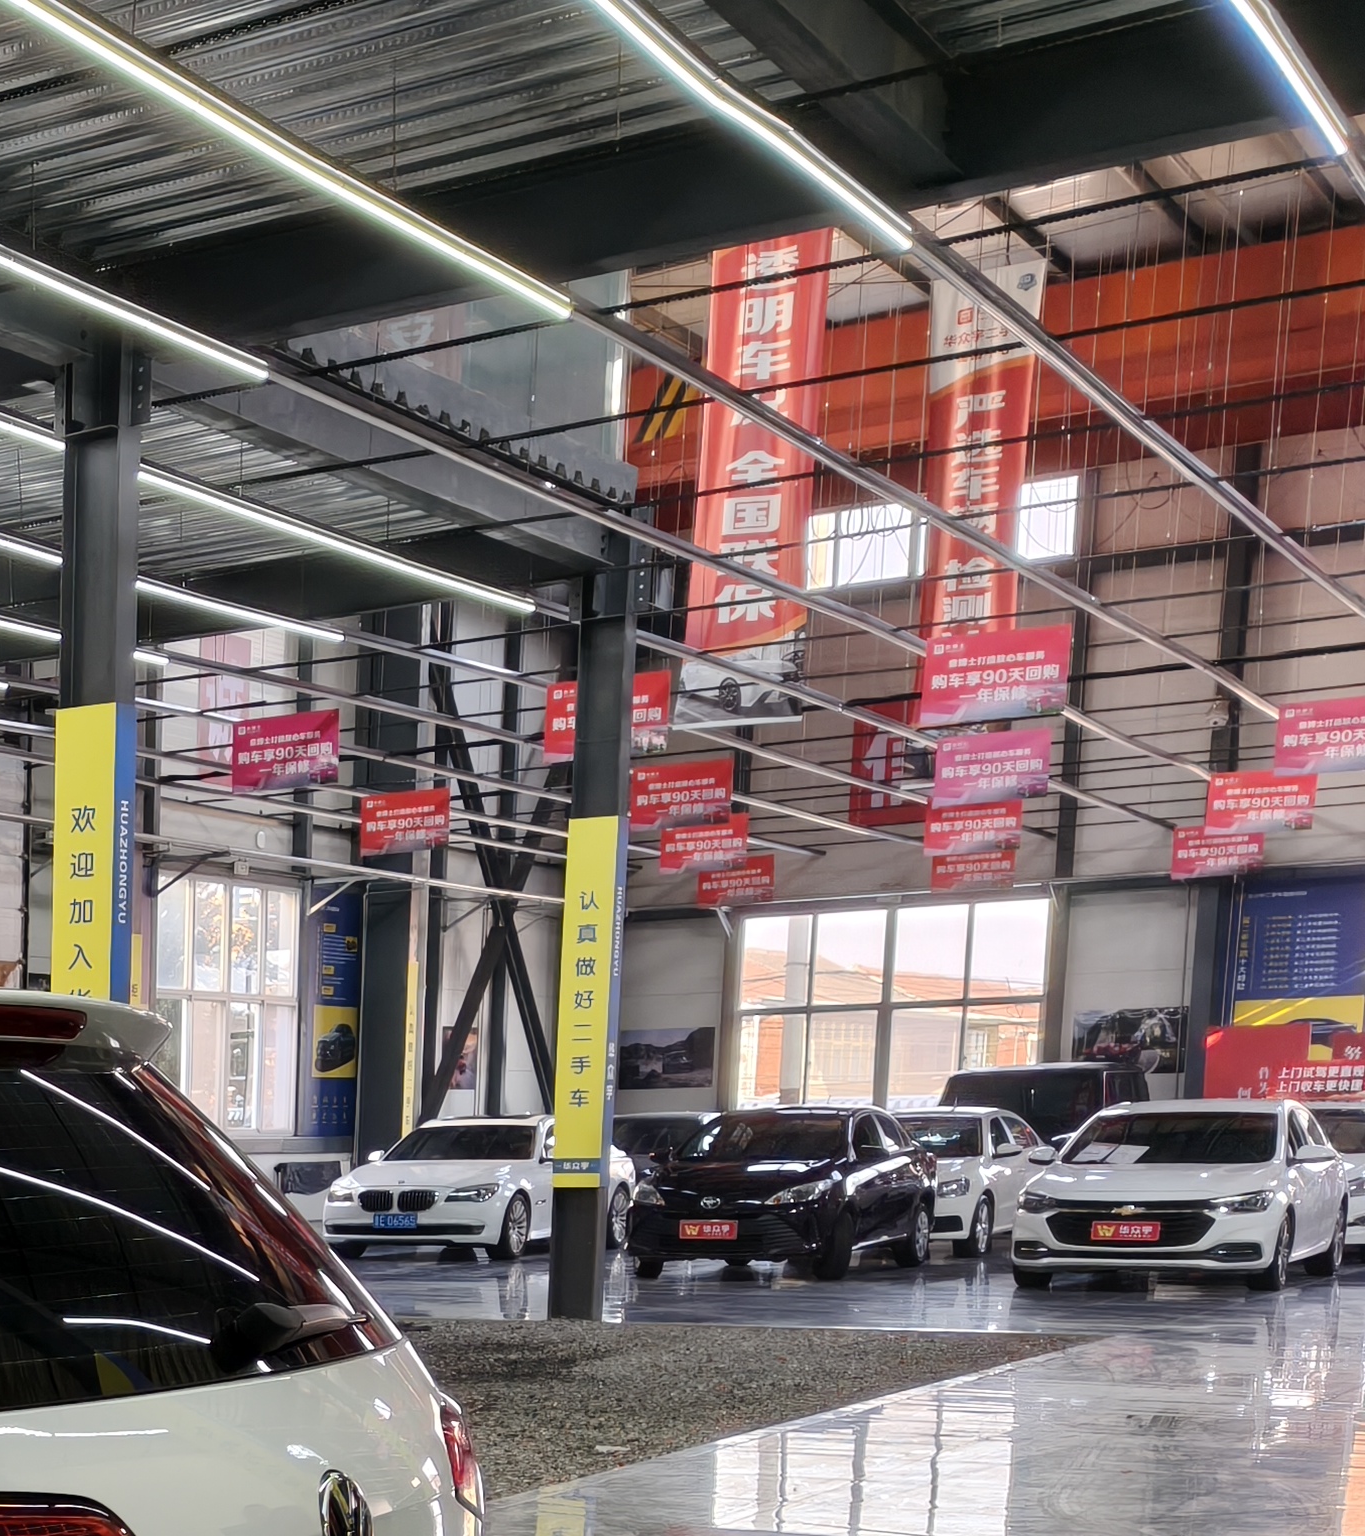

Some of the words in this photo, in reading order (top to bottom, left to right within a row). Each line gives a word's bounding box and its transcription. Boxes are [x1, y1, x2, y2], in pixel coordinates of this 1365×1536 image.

[943, 327, 1009, 348] 华众宇二手
[931, 664, 1060, 690] 购车享90天回购
[959, 685, 1028, 702] 一年保修
[237, 742, 333, 765] 购车享90天回购
[259, 760, 310, 776] 一年保修
[941, 759, 1043, 779] 购车享90天回购
[117, 800, 129, 925] HUAZHONGYU
[569, 890, 600, 1108] 认真做好二手车
